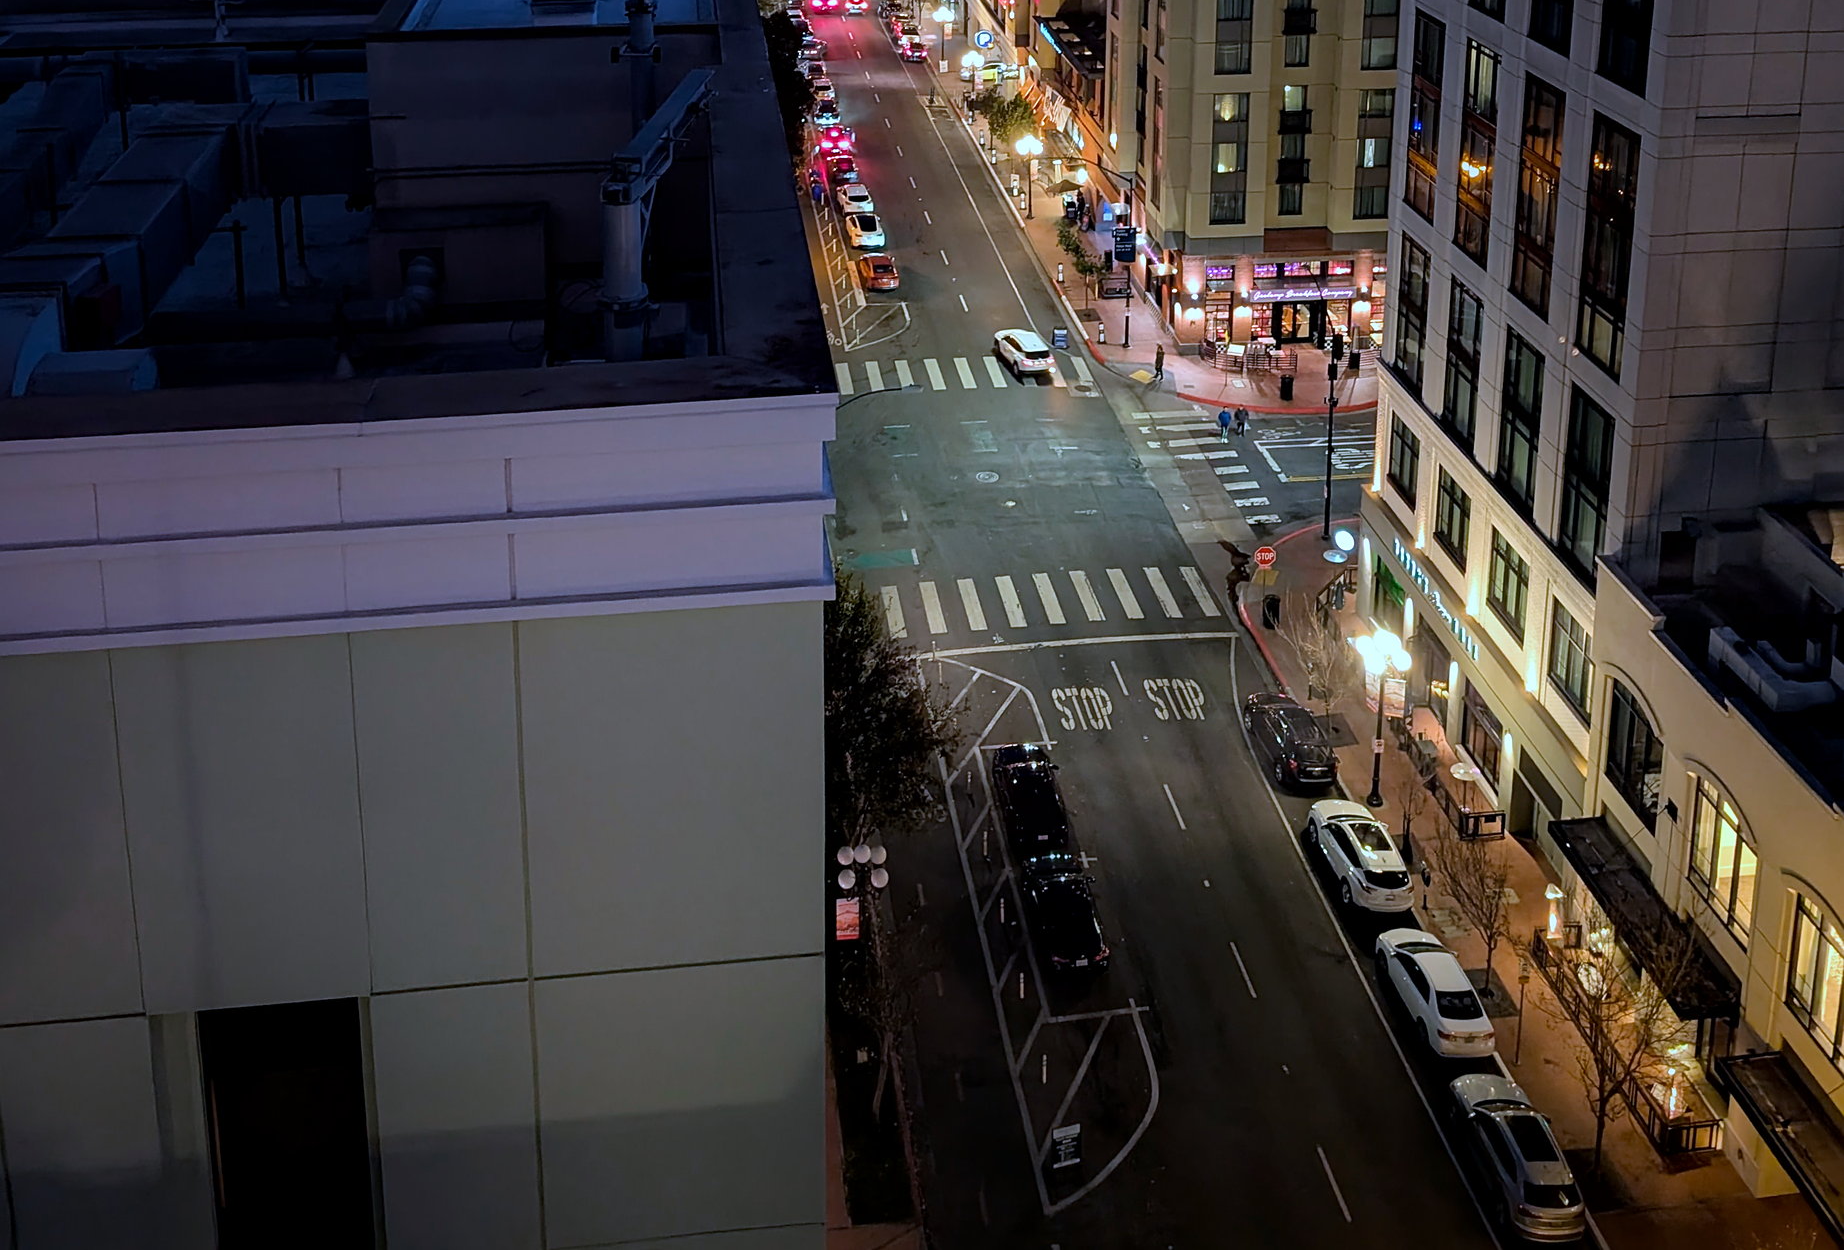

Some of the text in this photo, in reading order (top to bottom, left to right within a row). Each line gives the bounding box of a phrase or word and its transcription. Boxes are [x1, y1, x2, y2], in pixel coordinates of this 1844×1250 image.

[1256, 552, 1275, 561] STOP
[1051, 678, 1205, 731] STOP STOP
